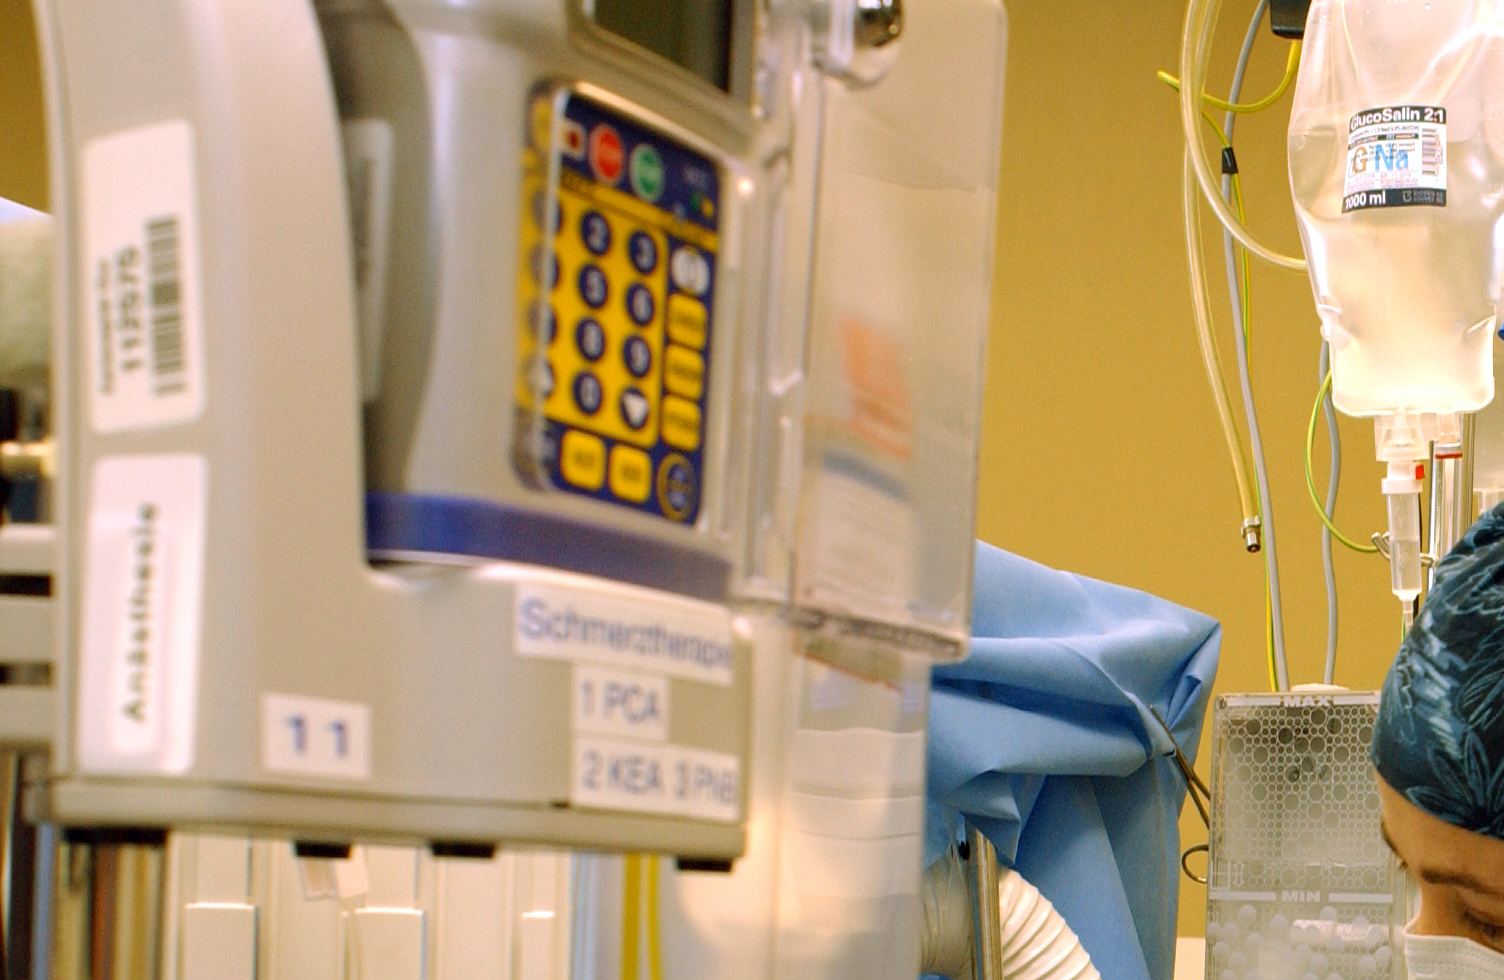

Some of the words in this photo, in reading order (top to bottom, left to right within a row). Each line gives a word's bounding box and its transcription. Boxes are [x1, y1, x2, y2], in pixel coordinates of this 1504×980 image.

[1424, 107, 1444, 123] 2:1
[1345, 192, 1367, 210] 1000
[1369, 190, 1386, 205] ml
[1284, 694, 1333, 707] MAX
[1282, 890, 1320, 903] MIN
